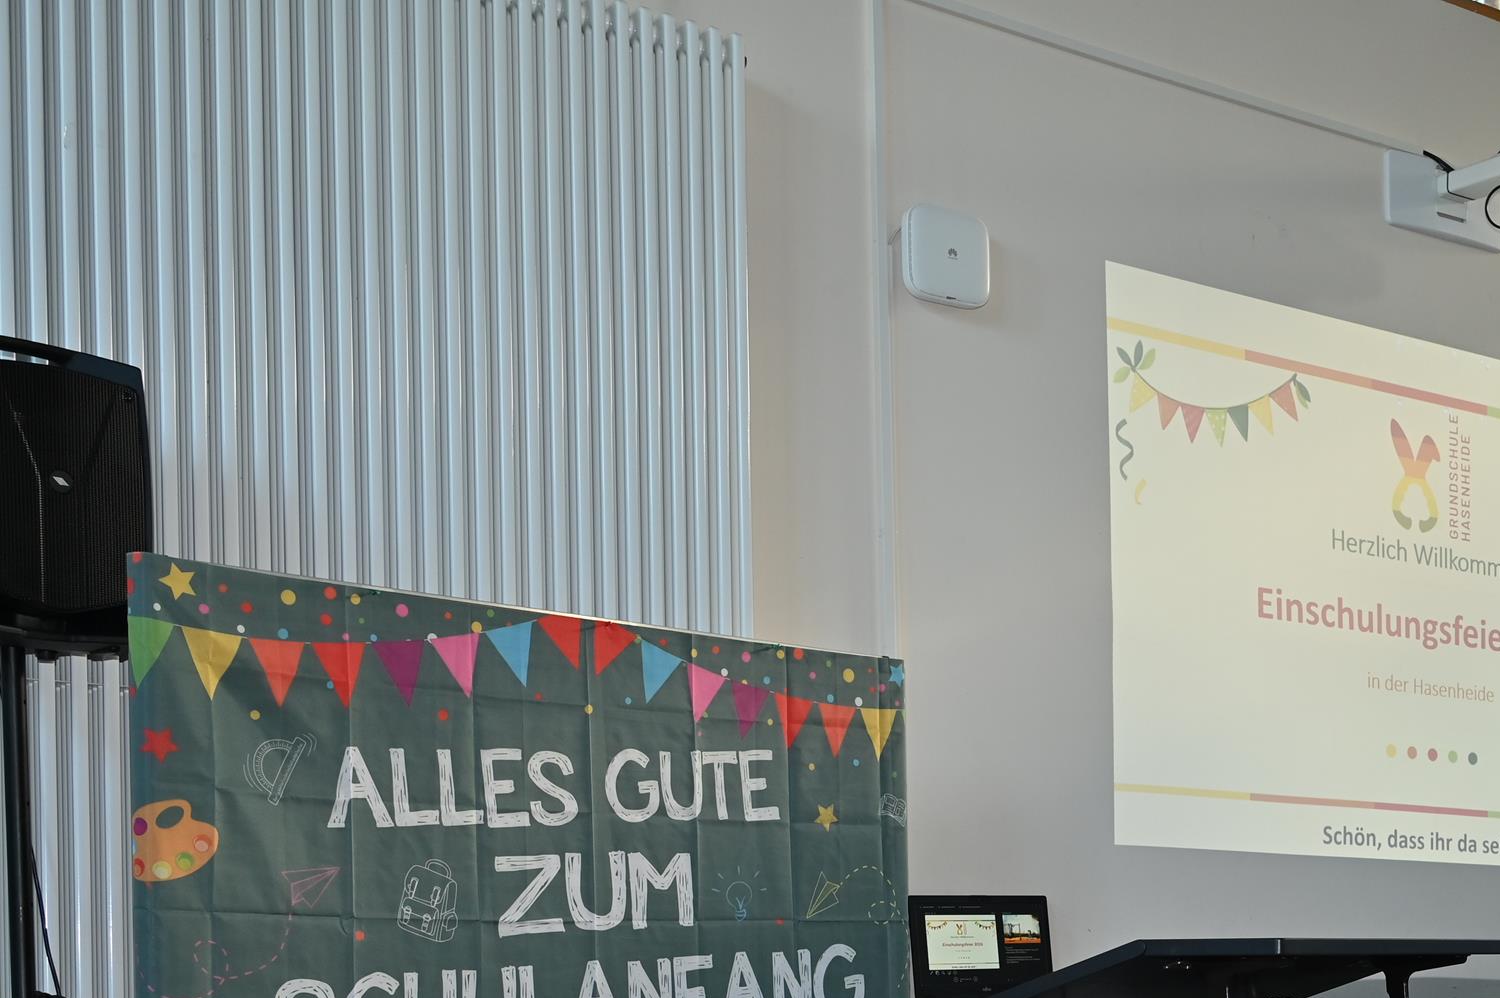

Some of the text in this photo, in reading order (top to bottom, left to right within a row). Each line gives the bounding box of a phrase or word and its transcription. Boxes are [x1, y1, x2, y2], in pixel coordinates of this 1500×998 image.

[1449, 413, 1459, 540] GRUNDSCHULE
[1461, 434, 1471, 542] HASENHEIDE
[1332, 528, 1407, 562] Herzlich
[1367, 671, 1495, 703] in der Hasenheide
[327, 745, 783, 829] ALLES GUTE
[1322, 825, 1382, 850] Schön,
[1387, 829, 1425, 850] dass
[1430, 831, 1453, 851] ihr
[1457, 833, 1478, 853] da
[494, 850, 694, 937] ZUM
